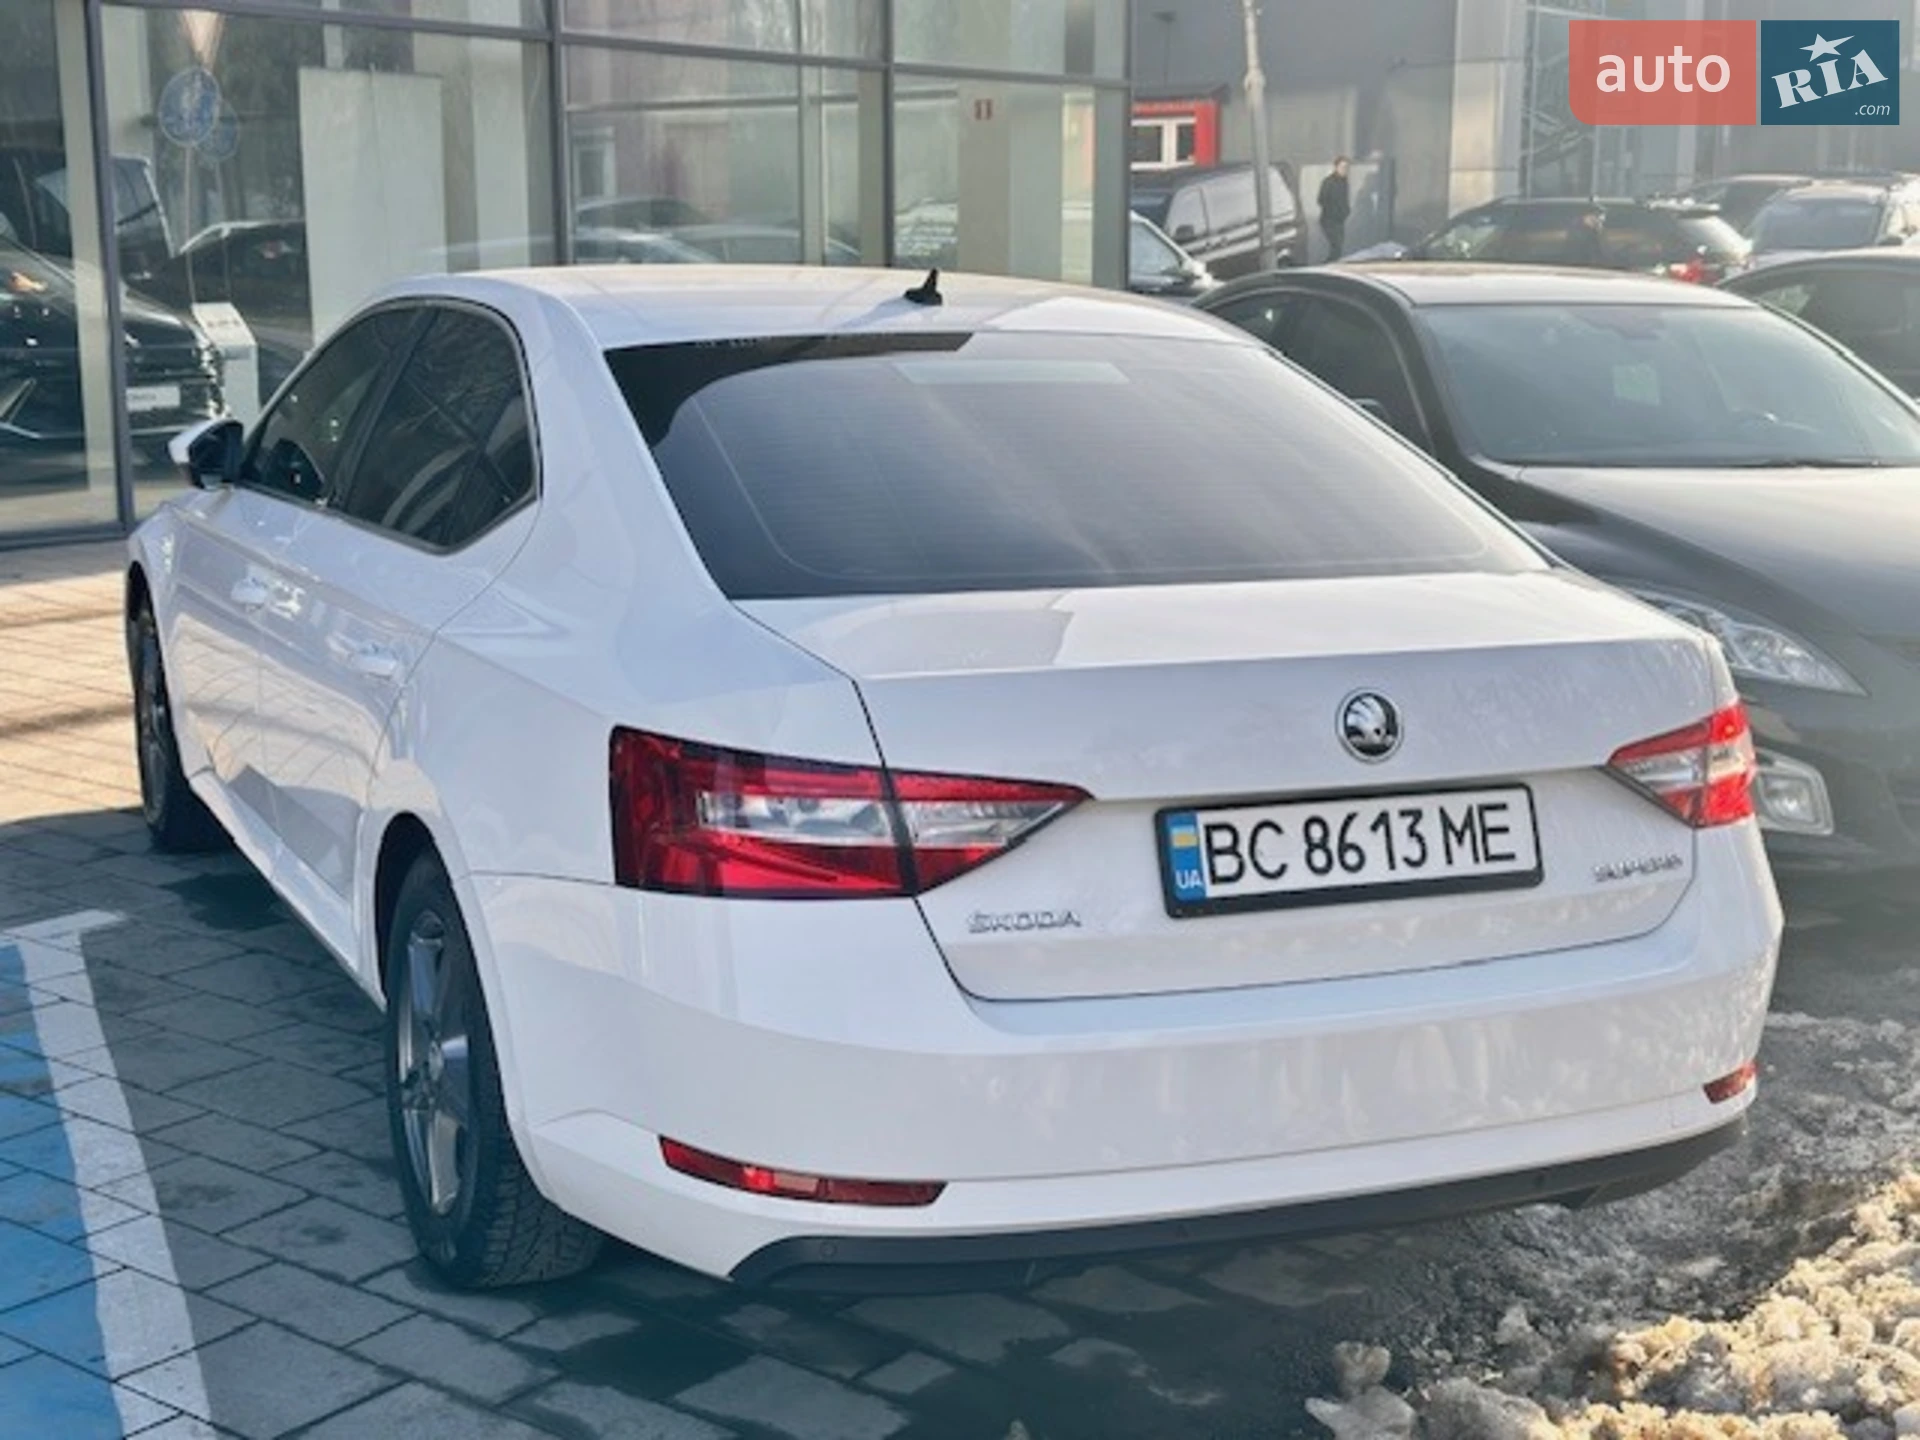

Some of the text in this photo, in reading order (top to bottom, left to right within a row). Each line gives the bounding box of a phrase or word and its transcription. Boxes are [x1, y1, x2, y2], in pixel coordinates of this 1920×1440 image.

[1204, 803, 1516, 886] BC 8613 ME
[1175, 870, 1202, 889] UA
